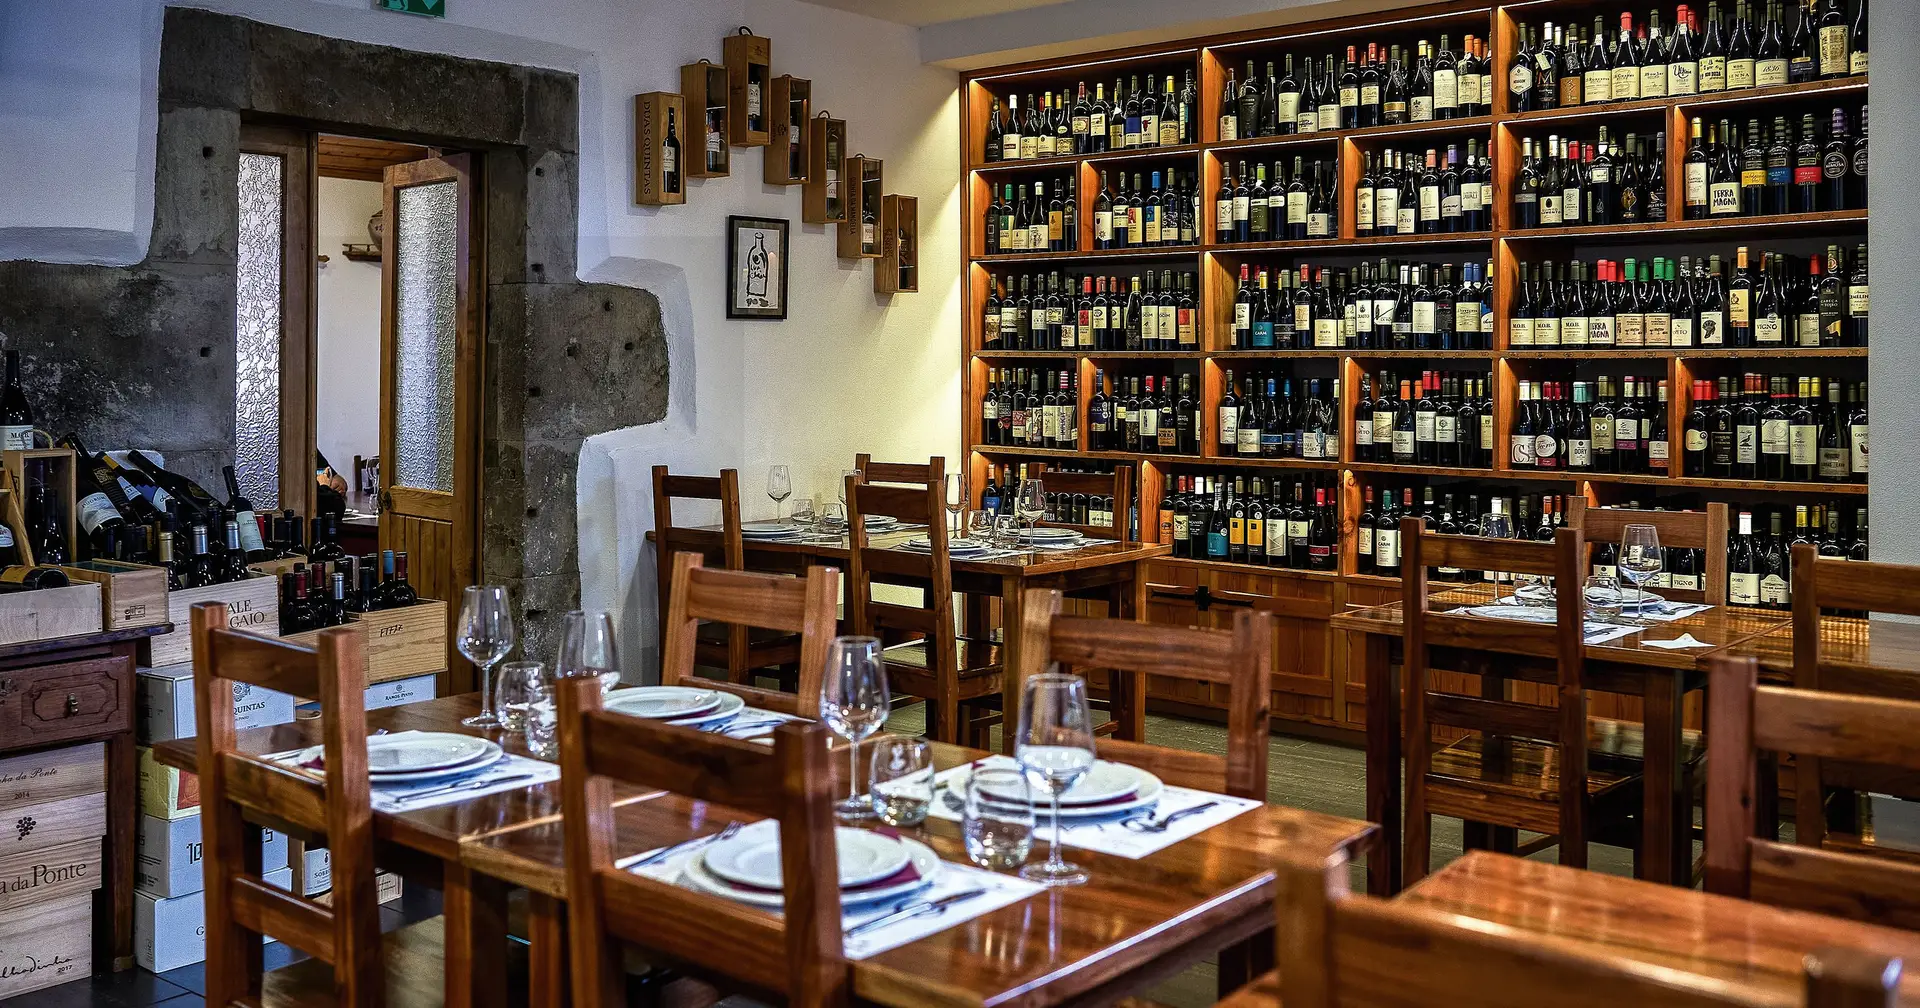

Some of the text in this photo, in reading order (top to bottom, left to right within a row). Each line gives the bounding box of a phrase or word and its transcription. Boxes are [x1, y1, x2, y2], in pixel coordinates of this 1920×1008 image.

[643, 101, 651, 195] DUAS QUINTAS
[1713, 189, 1734, 198] TERRA
[1713, 198, 1737, 207] MAGNA
[228, 600, 252, 614] ALE
[233, 702, 265, 715] QUINTAS
[16, 772, 27, 781] da
[30, 768, 57, 779] Ponte
[11, 877, 30, 892] da
[32, 863, 87, 888] Ponte
